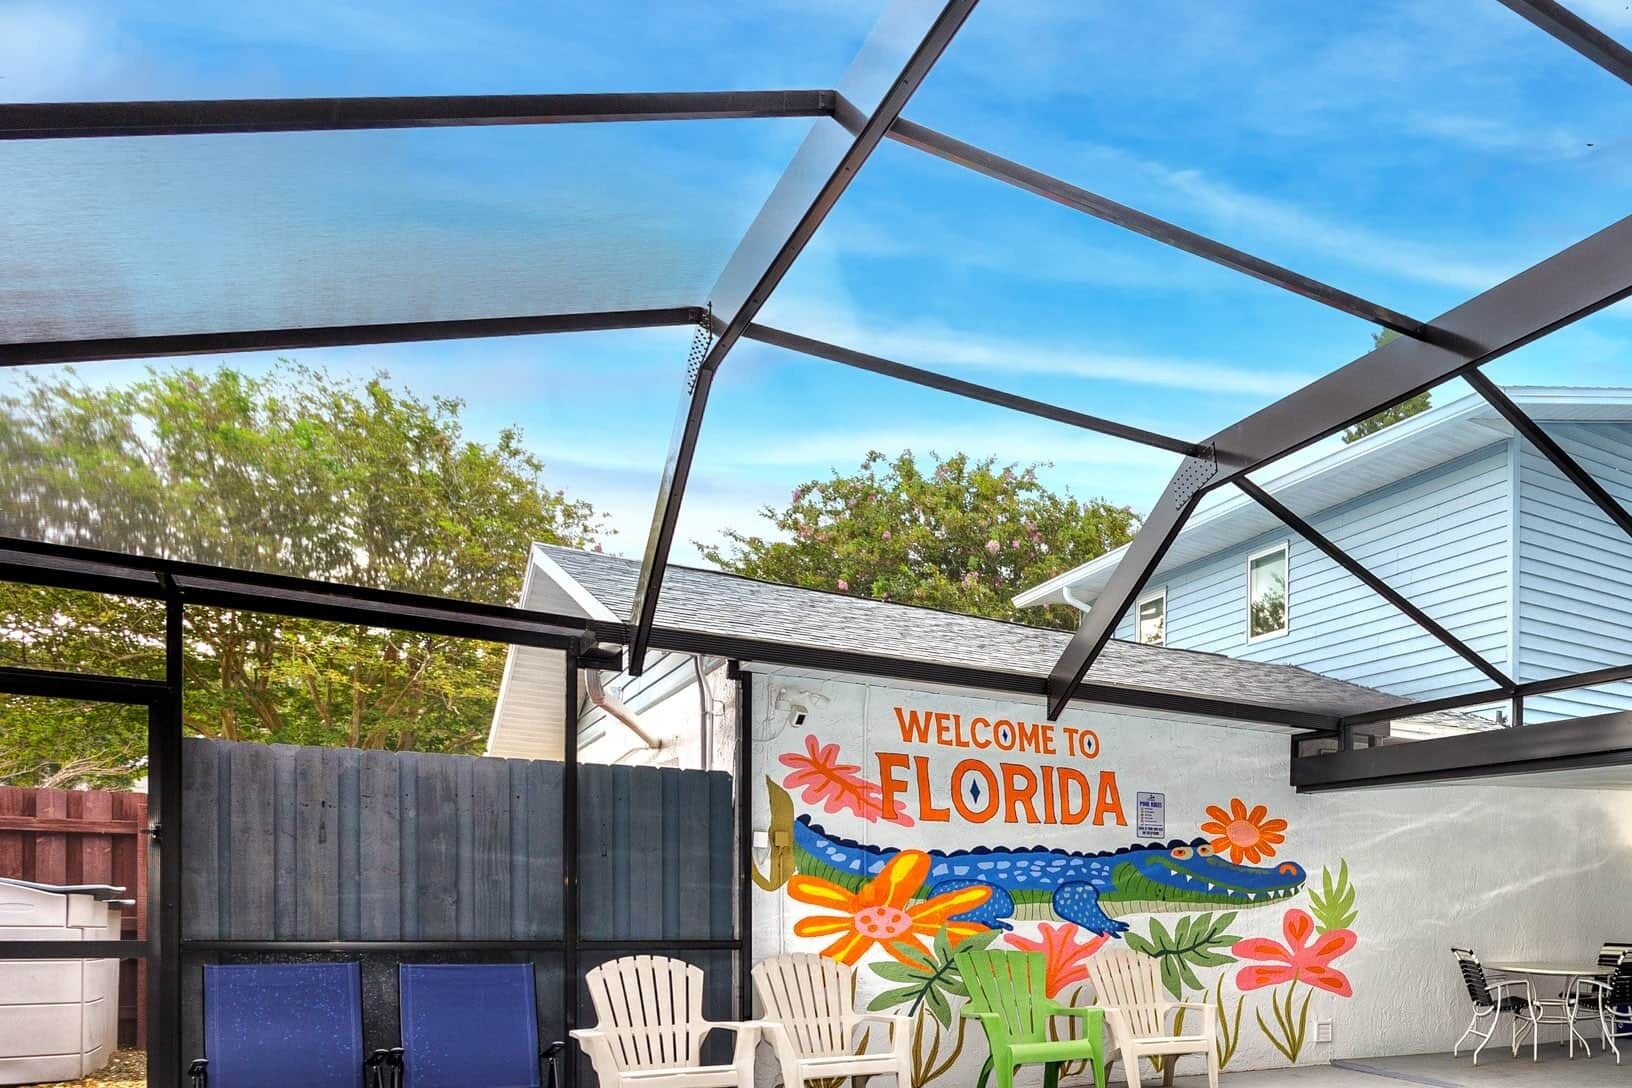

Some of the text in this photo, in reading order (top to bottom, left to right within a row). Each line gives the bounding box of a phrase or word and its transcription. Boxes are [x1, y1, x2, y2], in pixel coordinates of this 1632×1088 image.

[894, 707, 1100, 759] WELCOME TO
[875, 752, 1128, 827] FLORIDA
